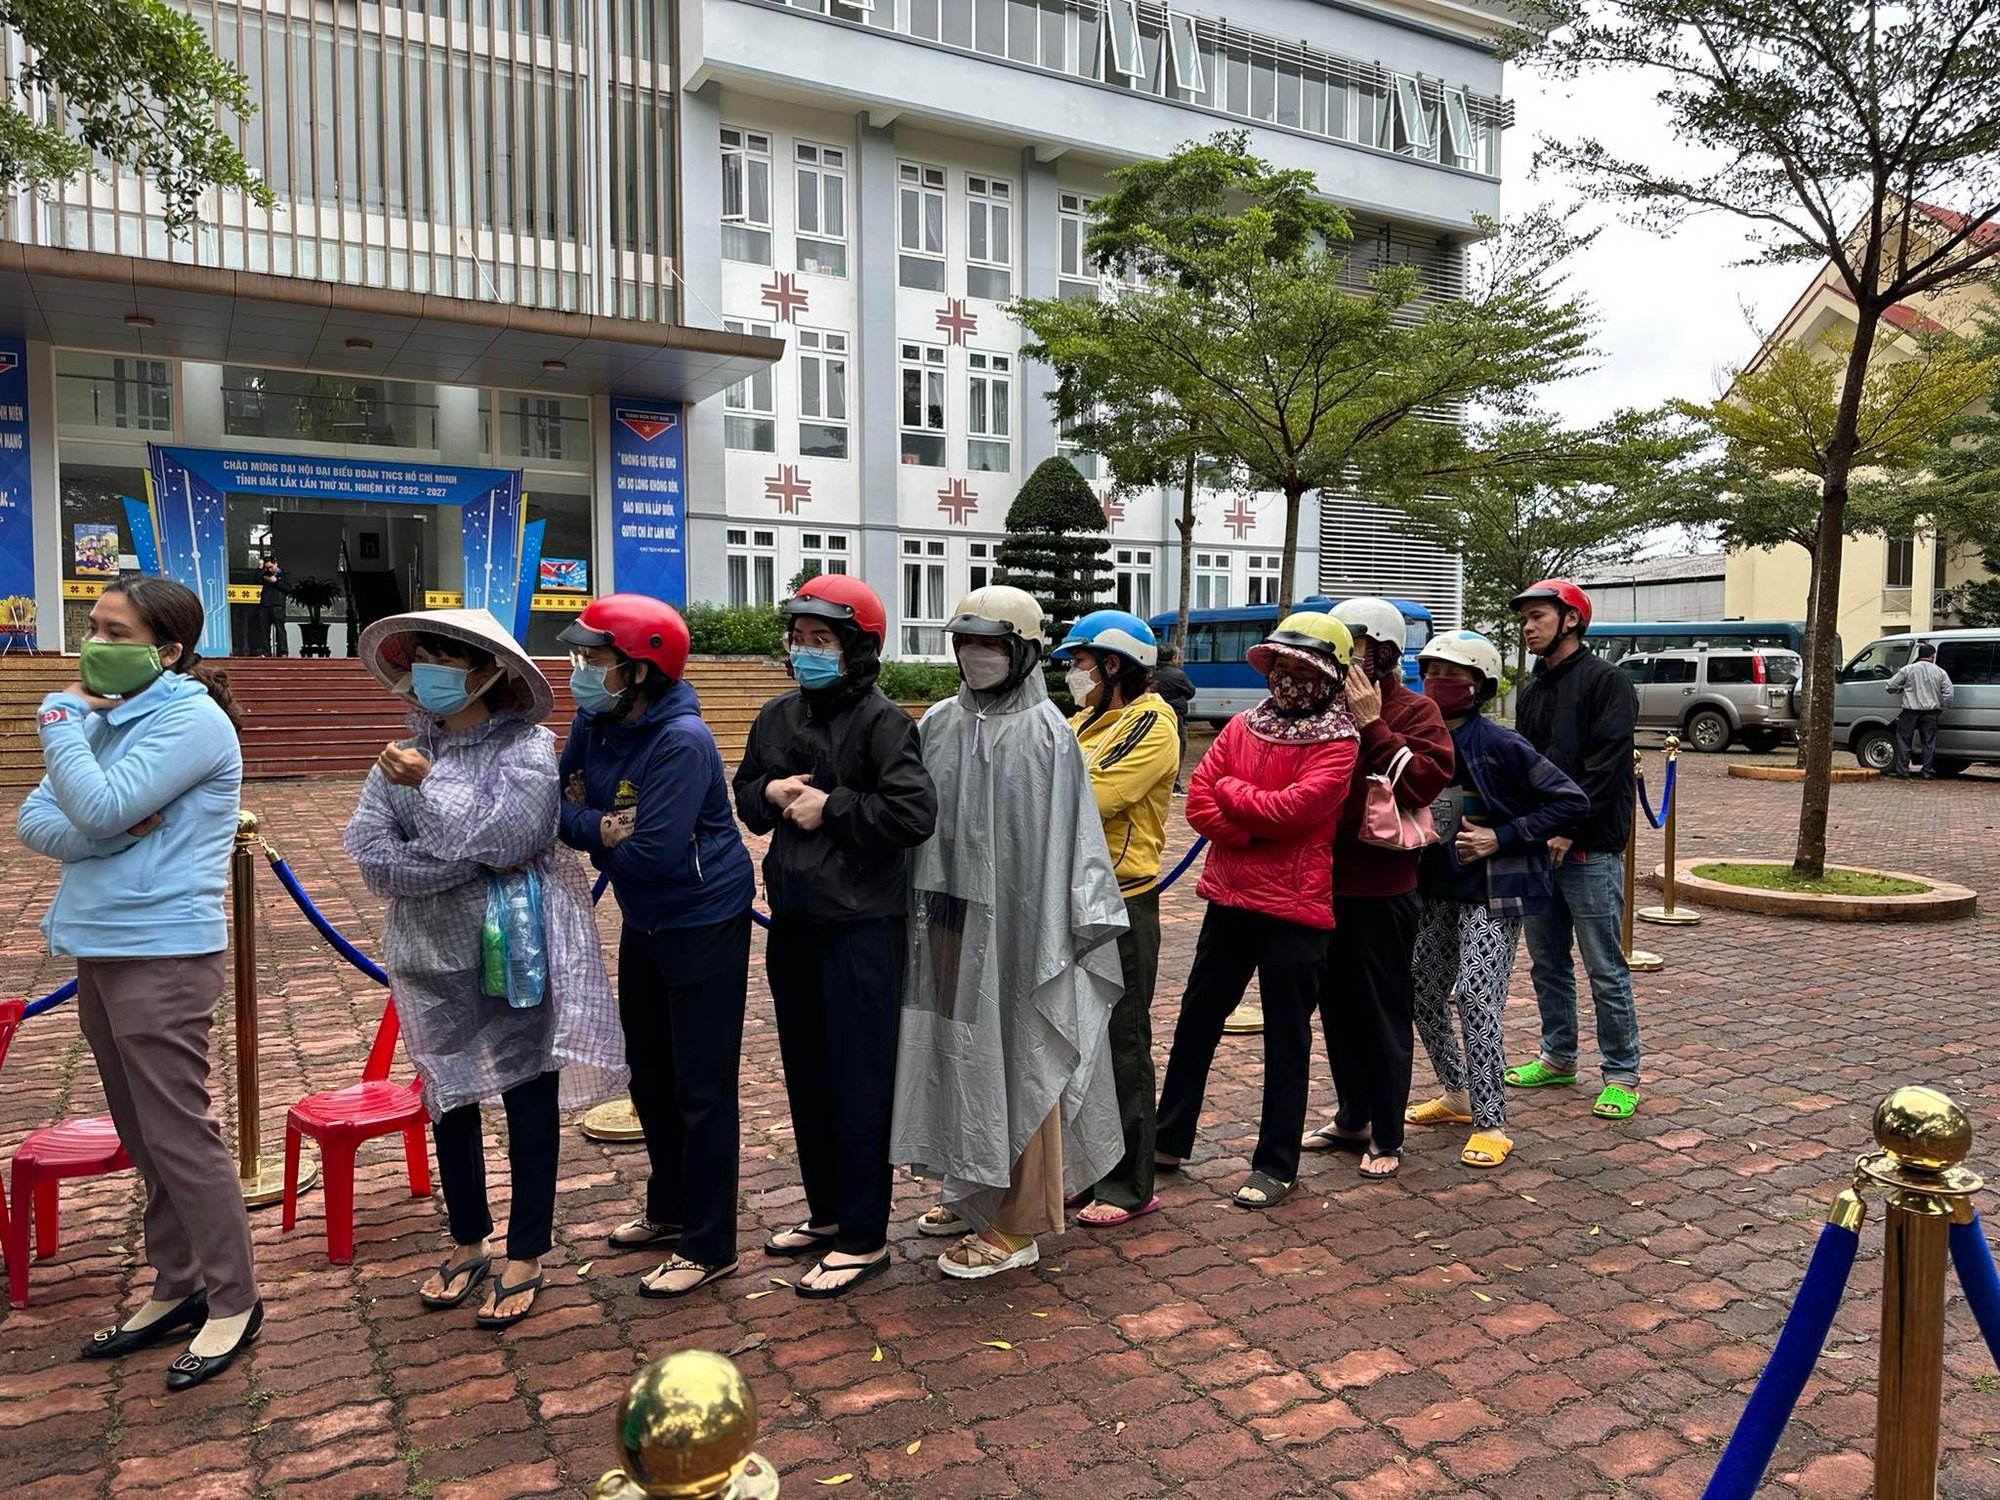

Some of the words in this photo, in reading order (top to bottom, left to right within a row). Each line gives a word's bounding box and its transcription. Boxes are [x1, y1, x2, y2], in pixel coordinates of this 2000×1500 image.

[223, 459, 248, 470] CHÀO
[251, 461, 278, 473] MỪNG
[280, 464, 296, 475] ĐẠI
[298, 463, 313, 476] HỘI
[316, 466, 330, 478] ĐẠI
[333, 465, 352, 477] BIỂU
[355, 468, 378, 479] ĐOÀN
[381, 471, 403, 481] TNCS
[405, 470, 416, 481] HỒ
[419, 473, 433, 483] CHÍ
[434, 475, 457, 484] MINH
[235, 473, 257, 485] TỈNH
[320, 480, 336, 491] THỨ
[338, 482, 352, 492] XII,
[355, 482, 383, 494] NHIỆM
[385, 484, 396, 494] KỲ
[399, 486, 419, 495] 2022
[426, 488, 446, 497] 2027
